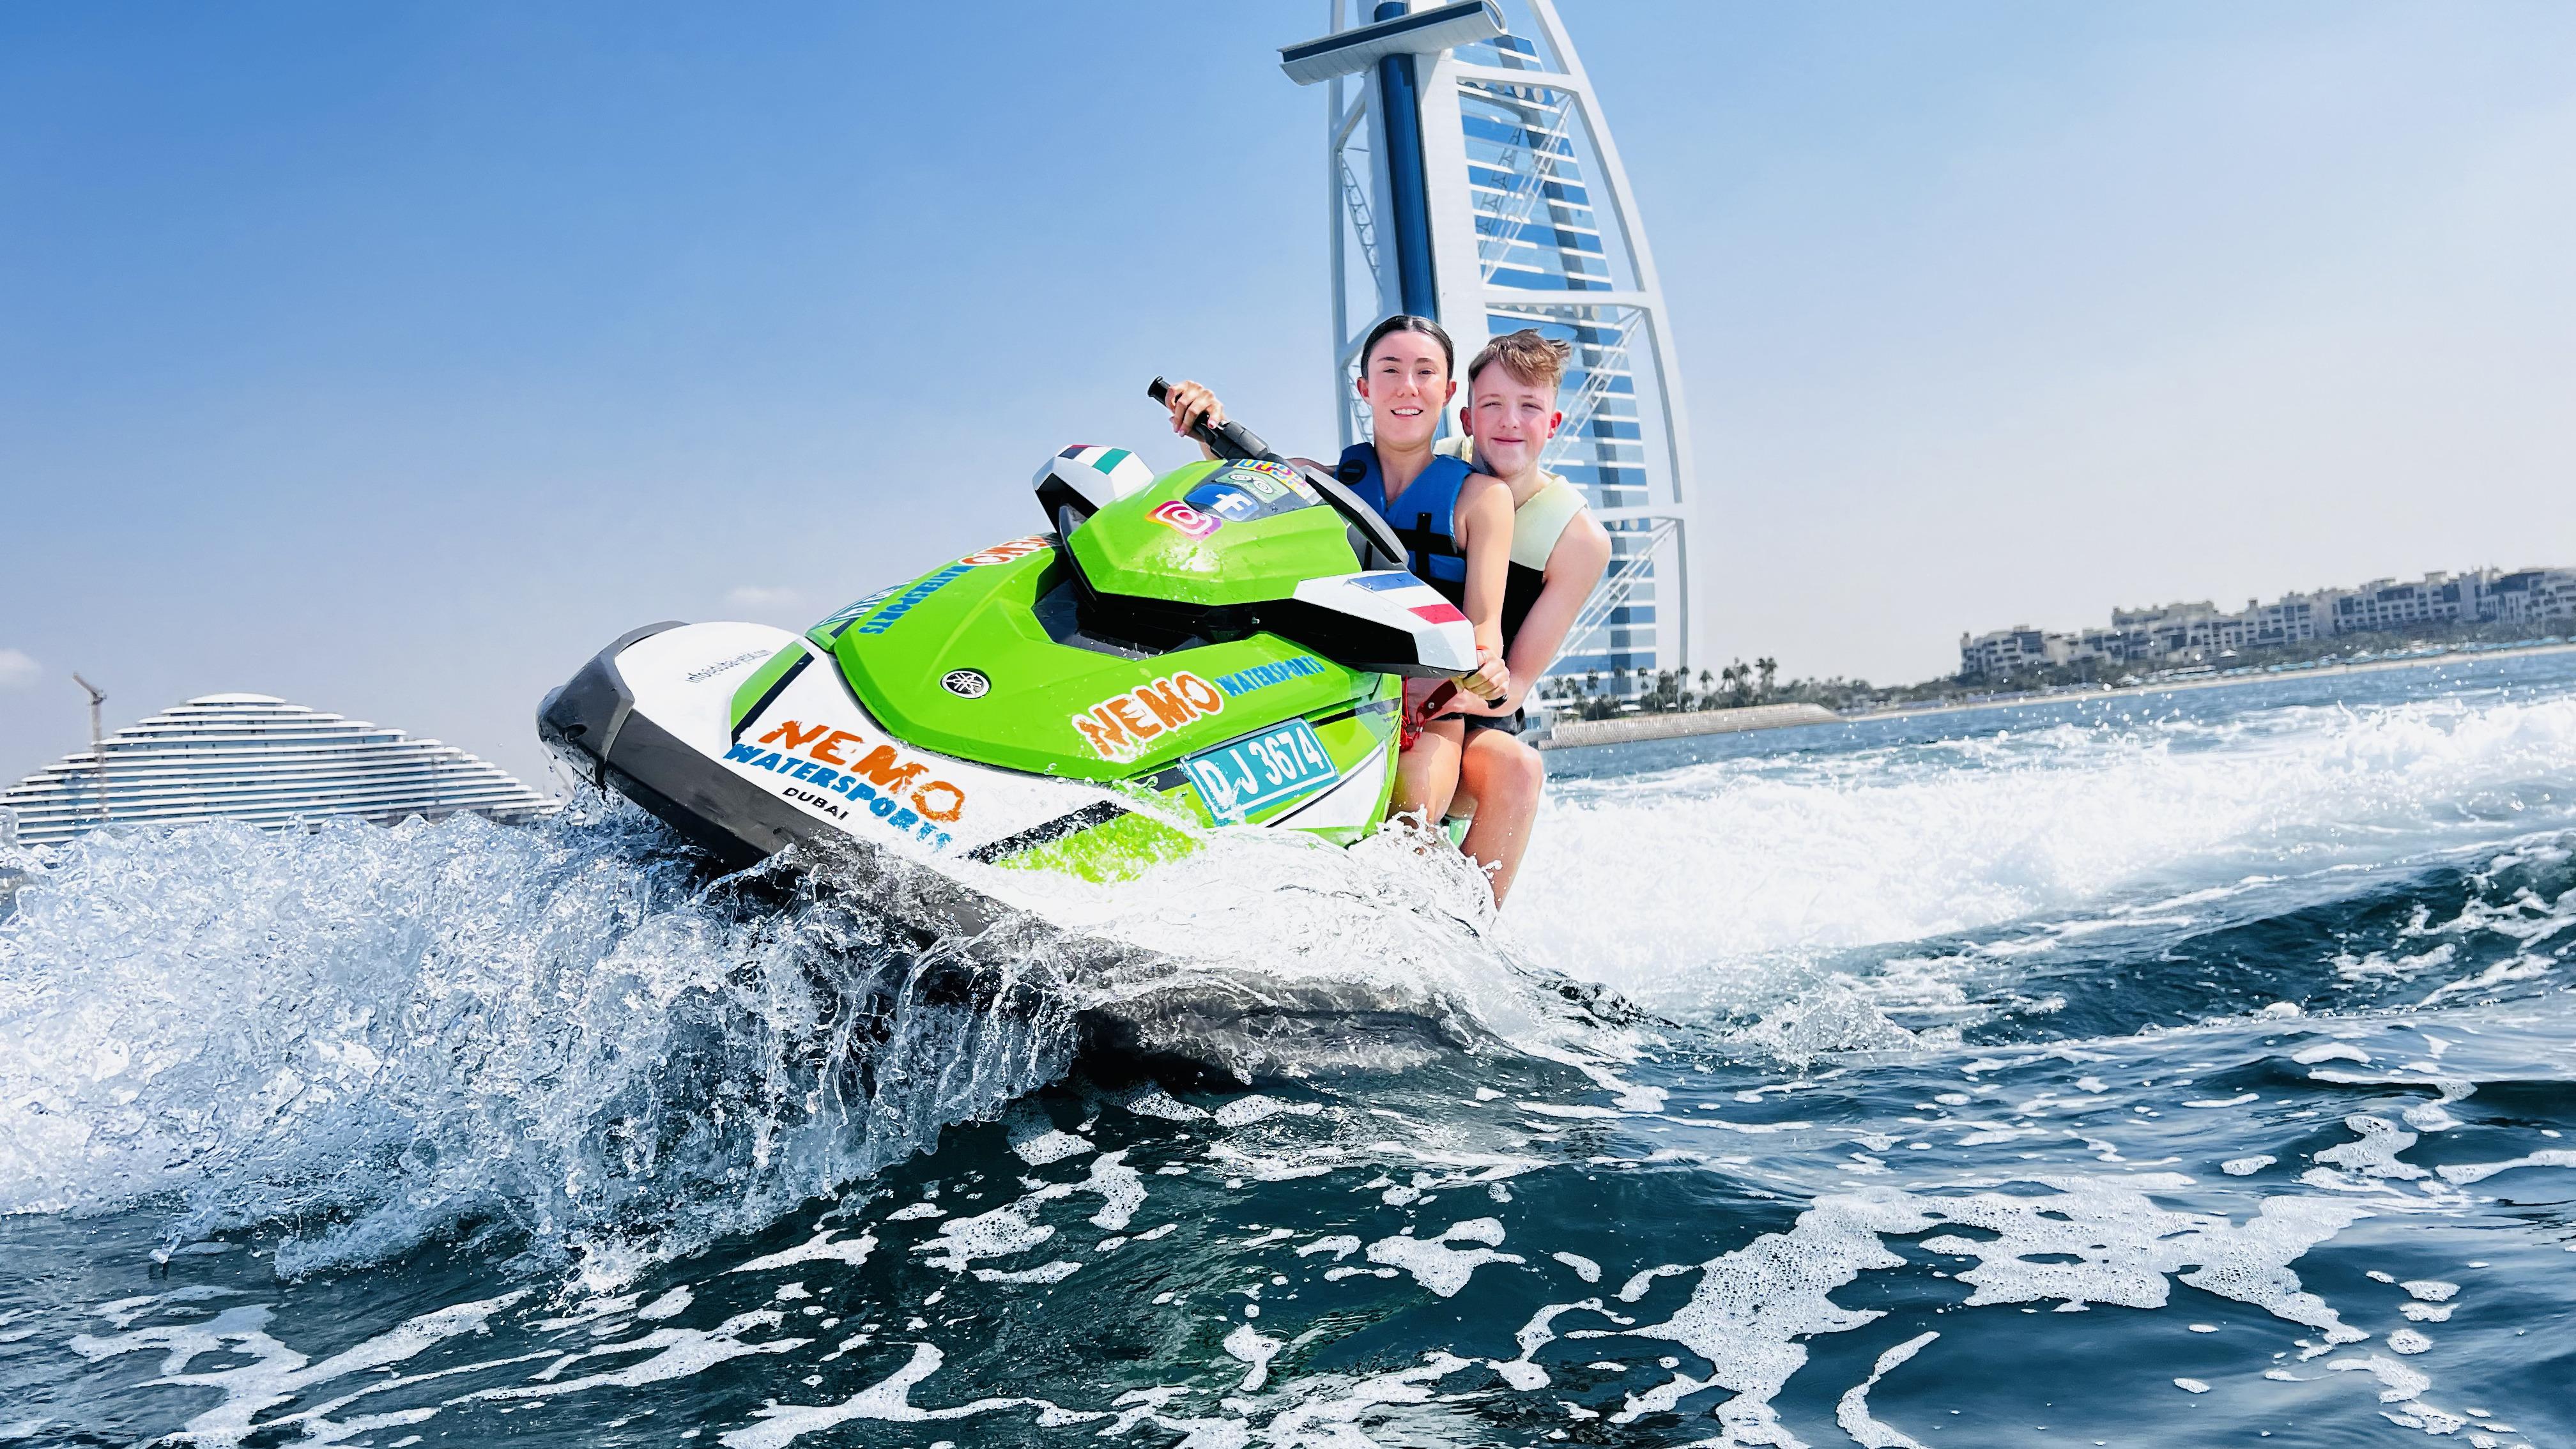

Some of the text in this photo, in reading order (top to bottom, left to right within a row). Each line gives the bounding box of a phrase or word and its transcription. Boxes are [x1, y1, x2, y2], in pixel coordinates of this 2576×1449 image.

[1080, 656, 1324, 756] NEMO WATERSPORTS
[1251, 726, 1325, 786] 3674
[723, 743, 953, 852] WATERSPORTS
[758, 720, 965, 822] NEMO
[781, 787, 849, 820] DUBAI
